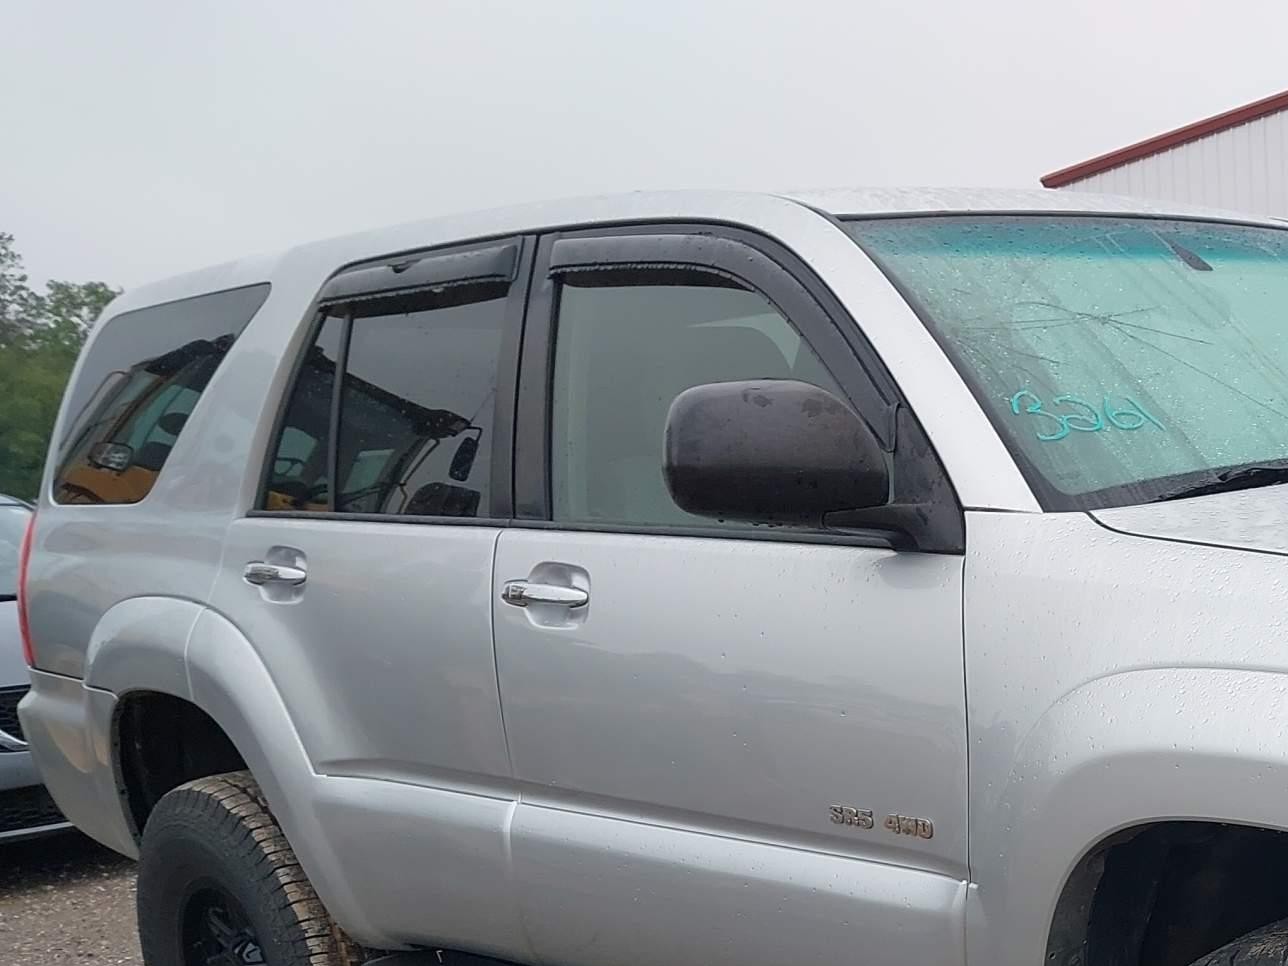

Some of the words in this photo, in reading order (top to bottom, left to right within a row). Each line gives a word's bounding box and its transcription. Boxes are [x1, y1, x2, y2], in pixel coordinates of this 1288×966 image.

[1010, 390, 1166, 441] 3261
[830, 805, 874, 829] SR5
[884, 814, 933, 839] 4WD
